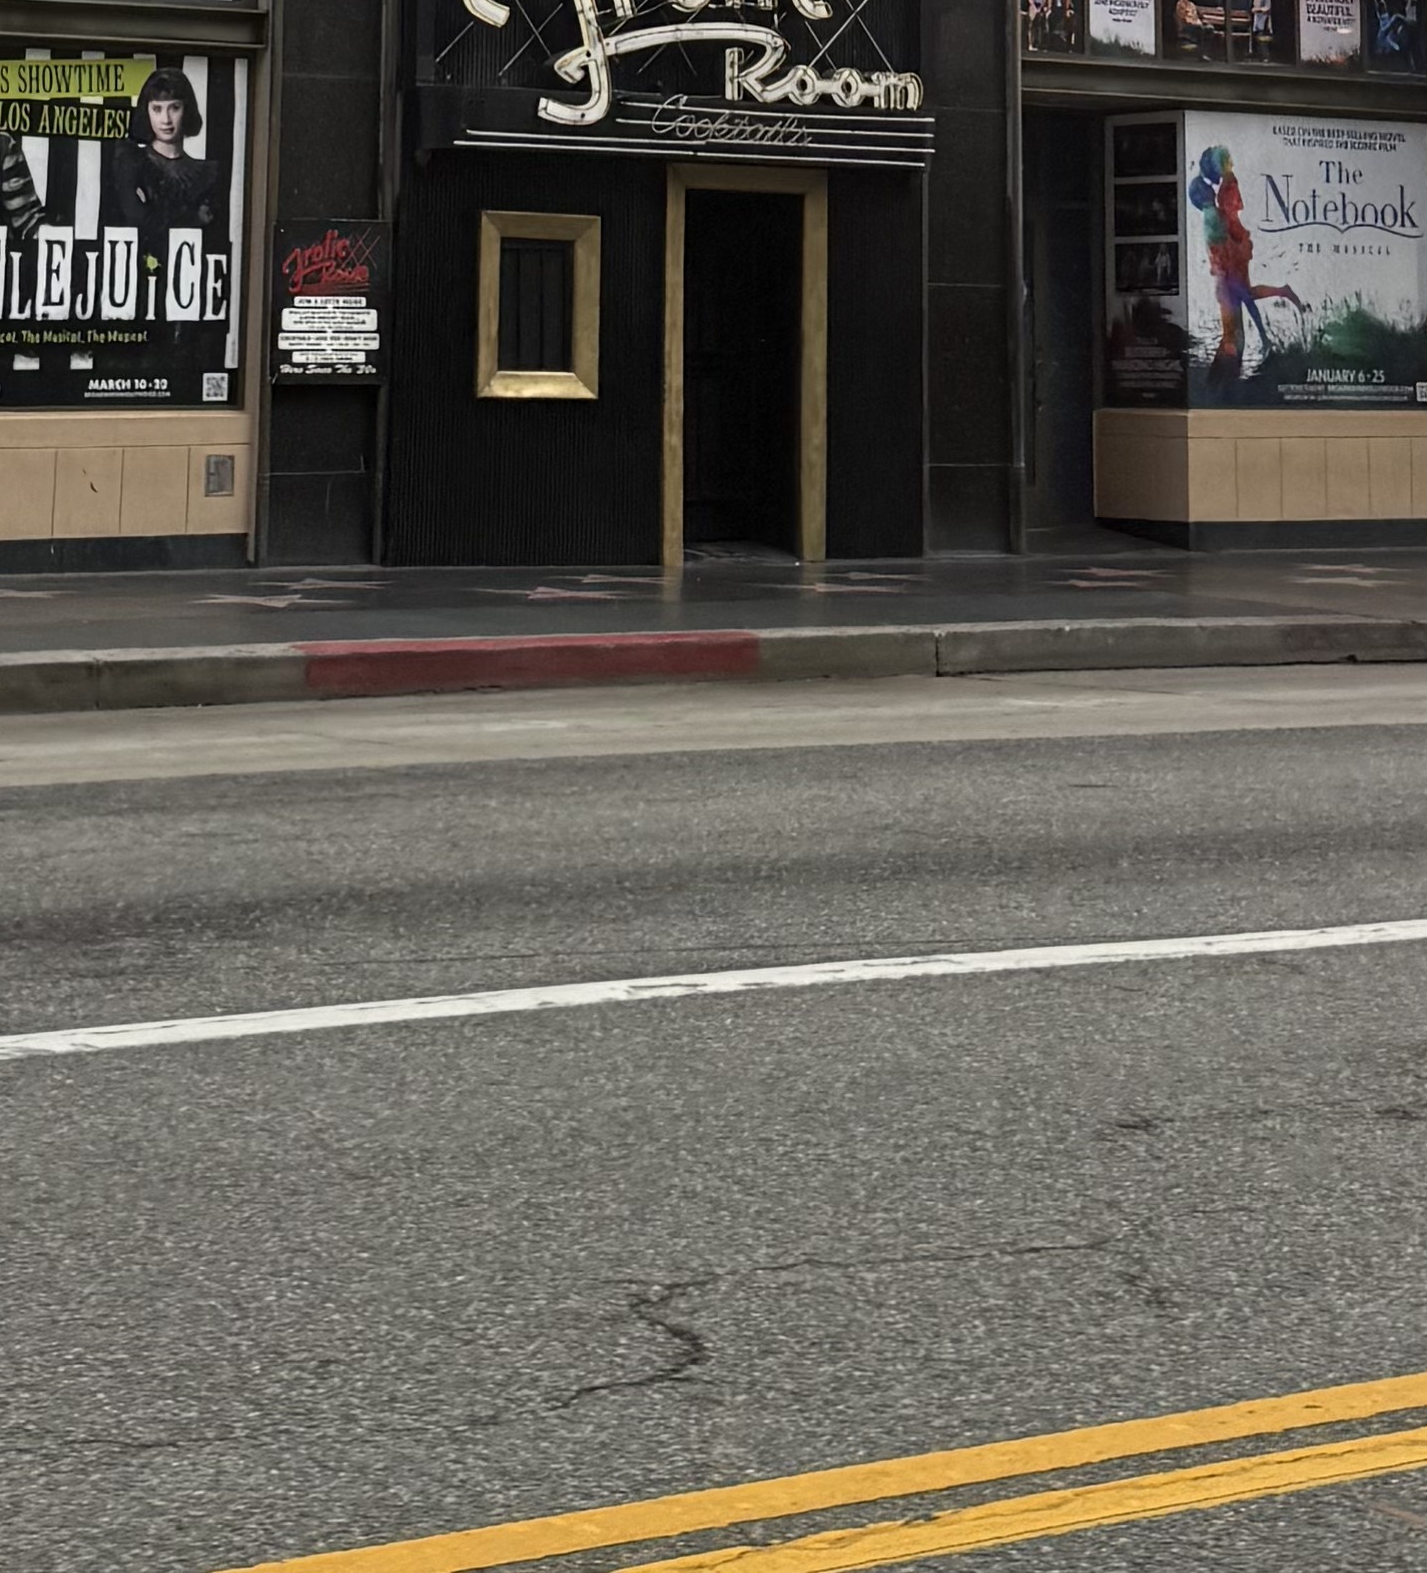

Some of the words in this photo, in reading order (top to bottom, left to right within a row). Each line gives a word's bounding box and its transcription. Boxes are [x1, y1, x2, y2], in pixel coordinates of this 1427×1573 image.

[17, 64, 125, 94] SHOWTIME
[607, 22, 923, 110] Room
[39, 105, 130, 139] ANGELES!
[652, 93, 811, 147] Cocktails
[1319, 160, 1365, 185] The
[1259, 173, 1419, 230] Notebook
[88, 379, 131, 390] MARCH
[1307, 368, 1356, 383] JANUARY
